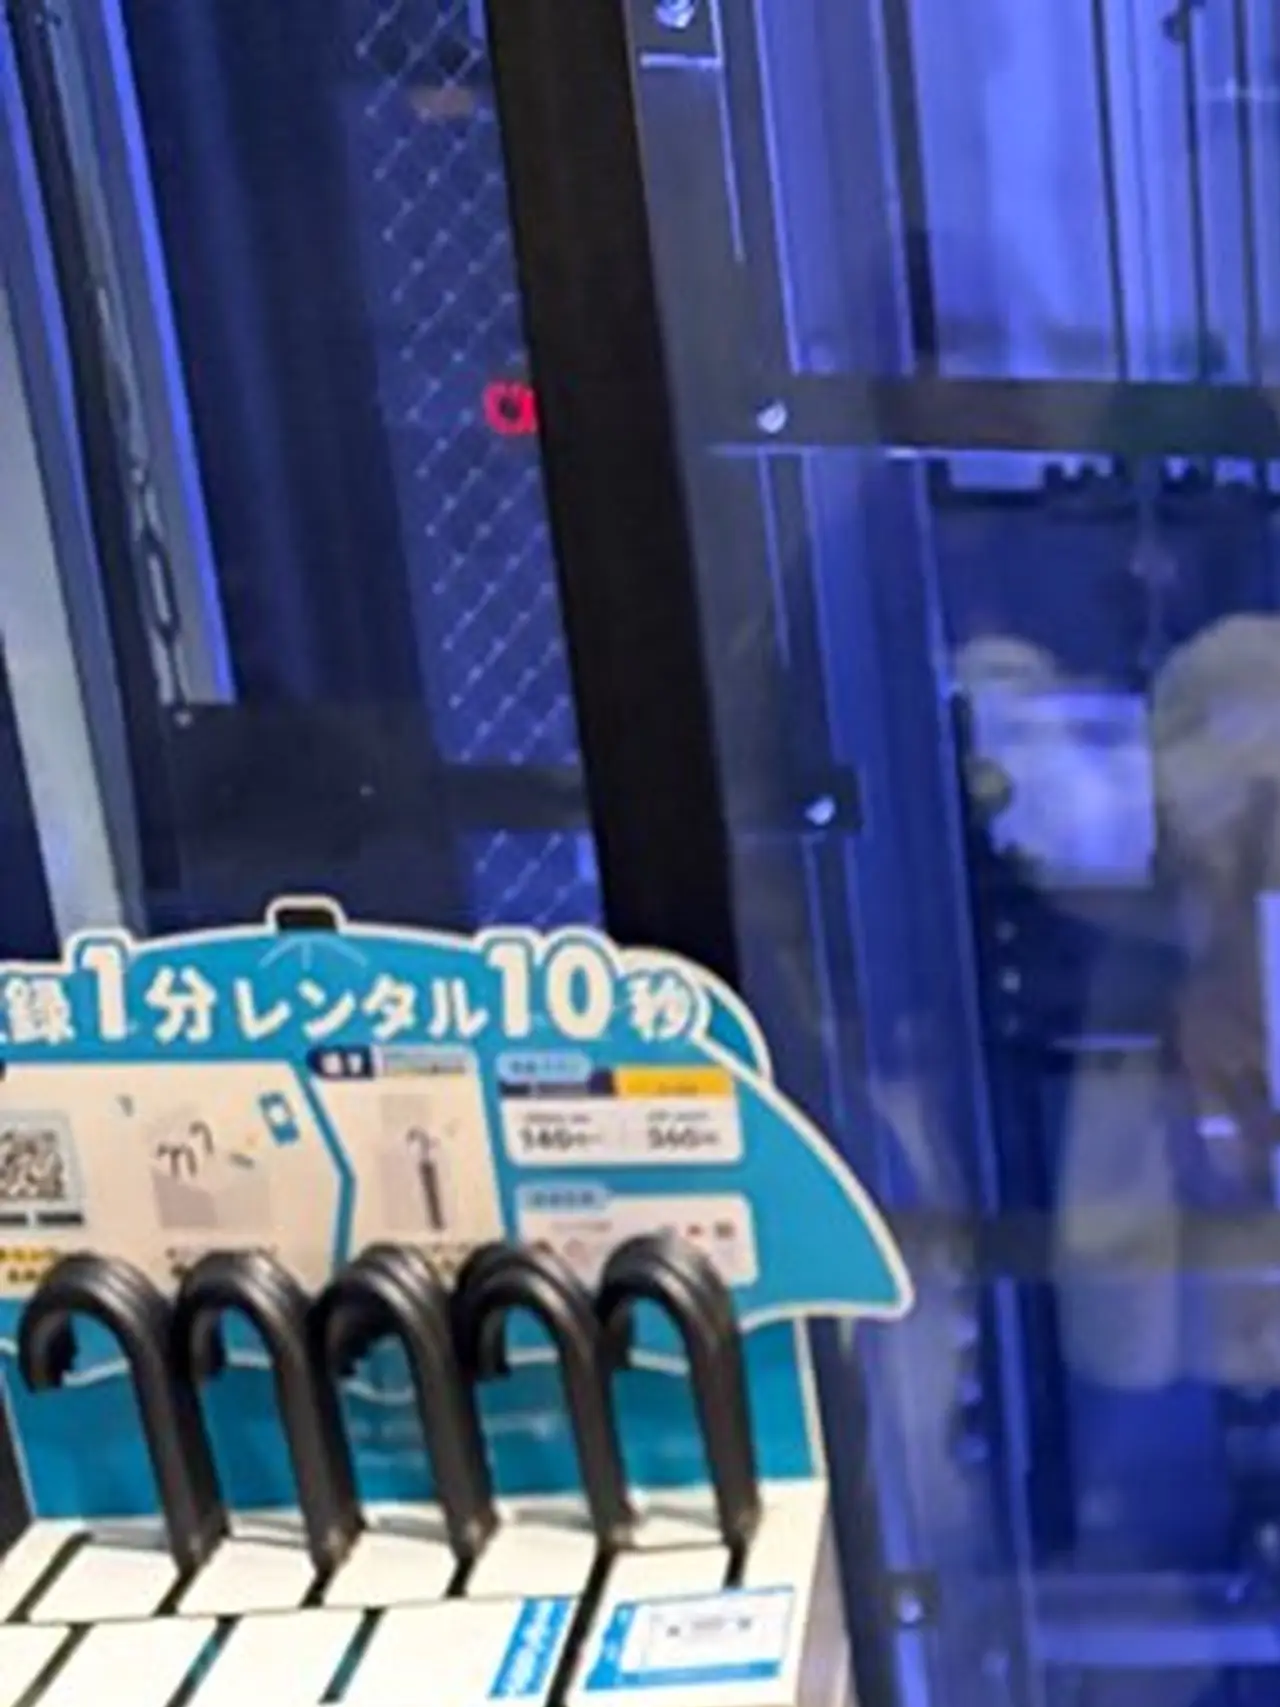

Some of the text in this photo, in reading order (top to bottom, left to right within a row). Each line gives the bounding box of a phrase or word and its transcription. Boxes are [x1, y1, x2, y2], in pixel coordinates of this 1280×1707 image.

[0, 942, 692, 1043] 録1分レンタル10秒
